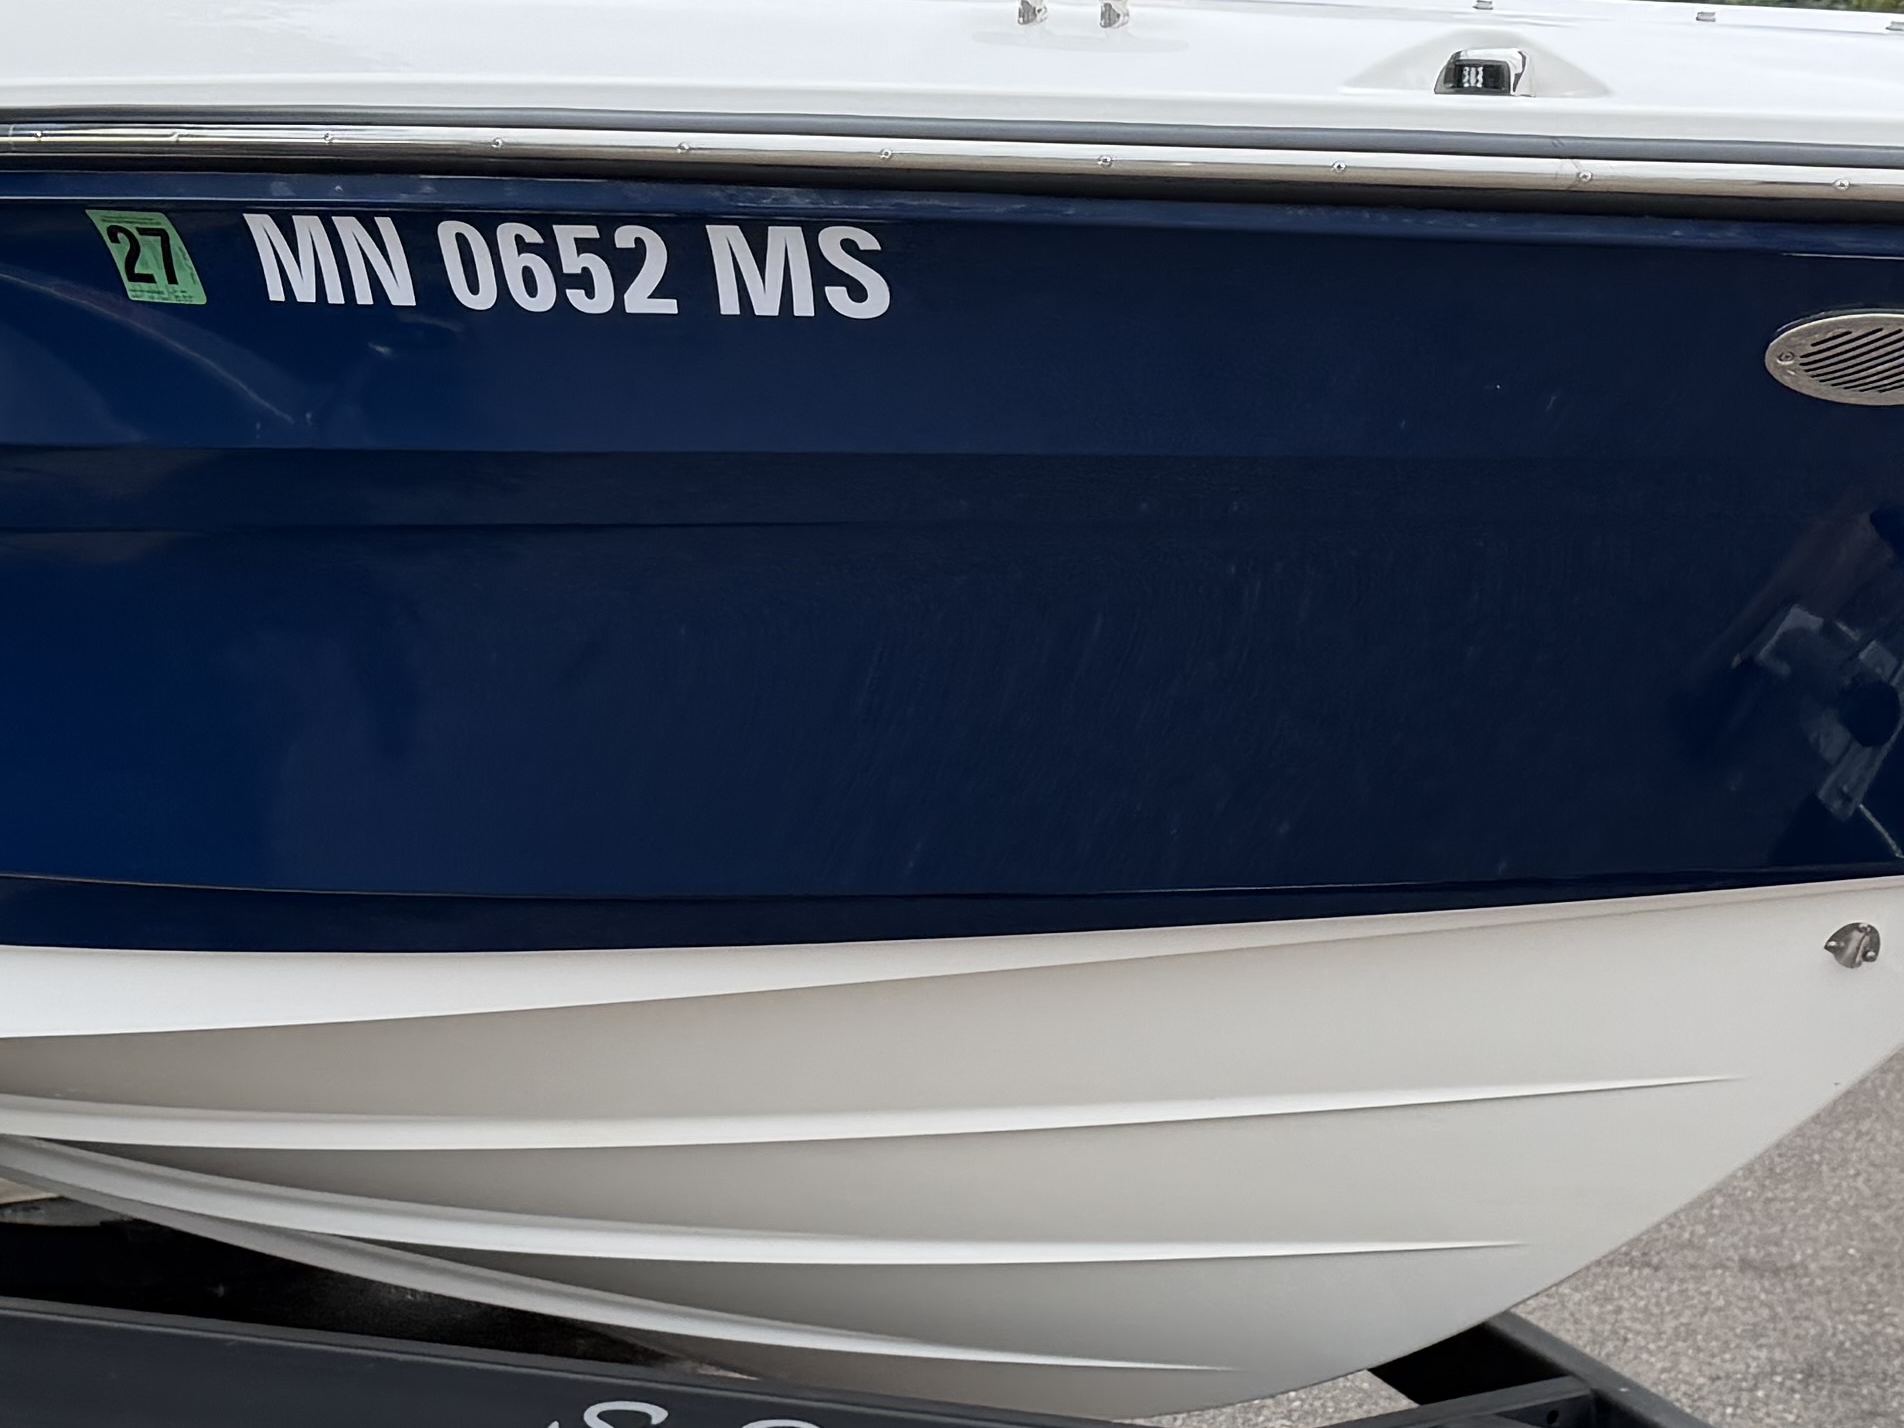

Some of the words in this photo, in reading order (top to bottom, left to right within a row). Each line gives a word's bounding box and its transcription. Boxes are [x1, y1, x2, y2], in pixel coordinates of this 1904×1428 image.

[106, 224, 178, 285] 27
[243, 214, 416, 306] MN
[438, 221, 678, 314] 0652
[706, 225, 890, 318] MS
